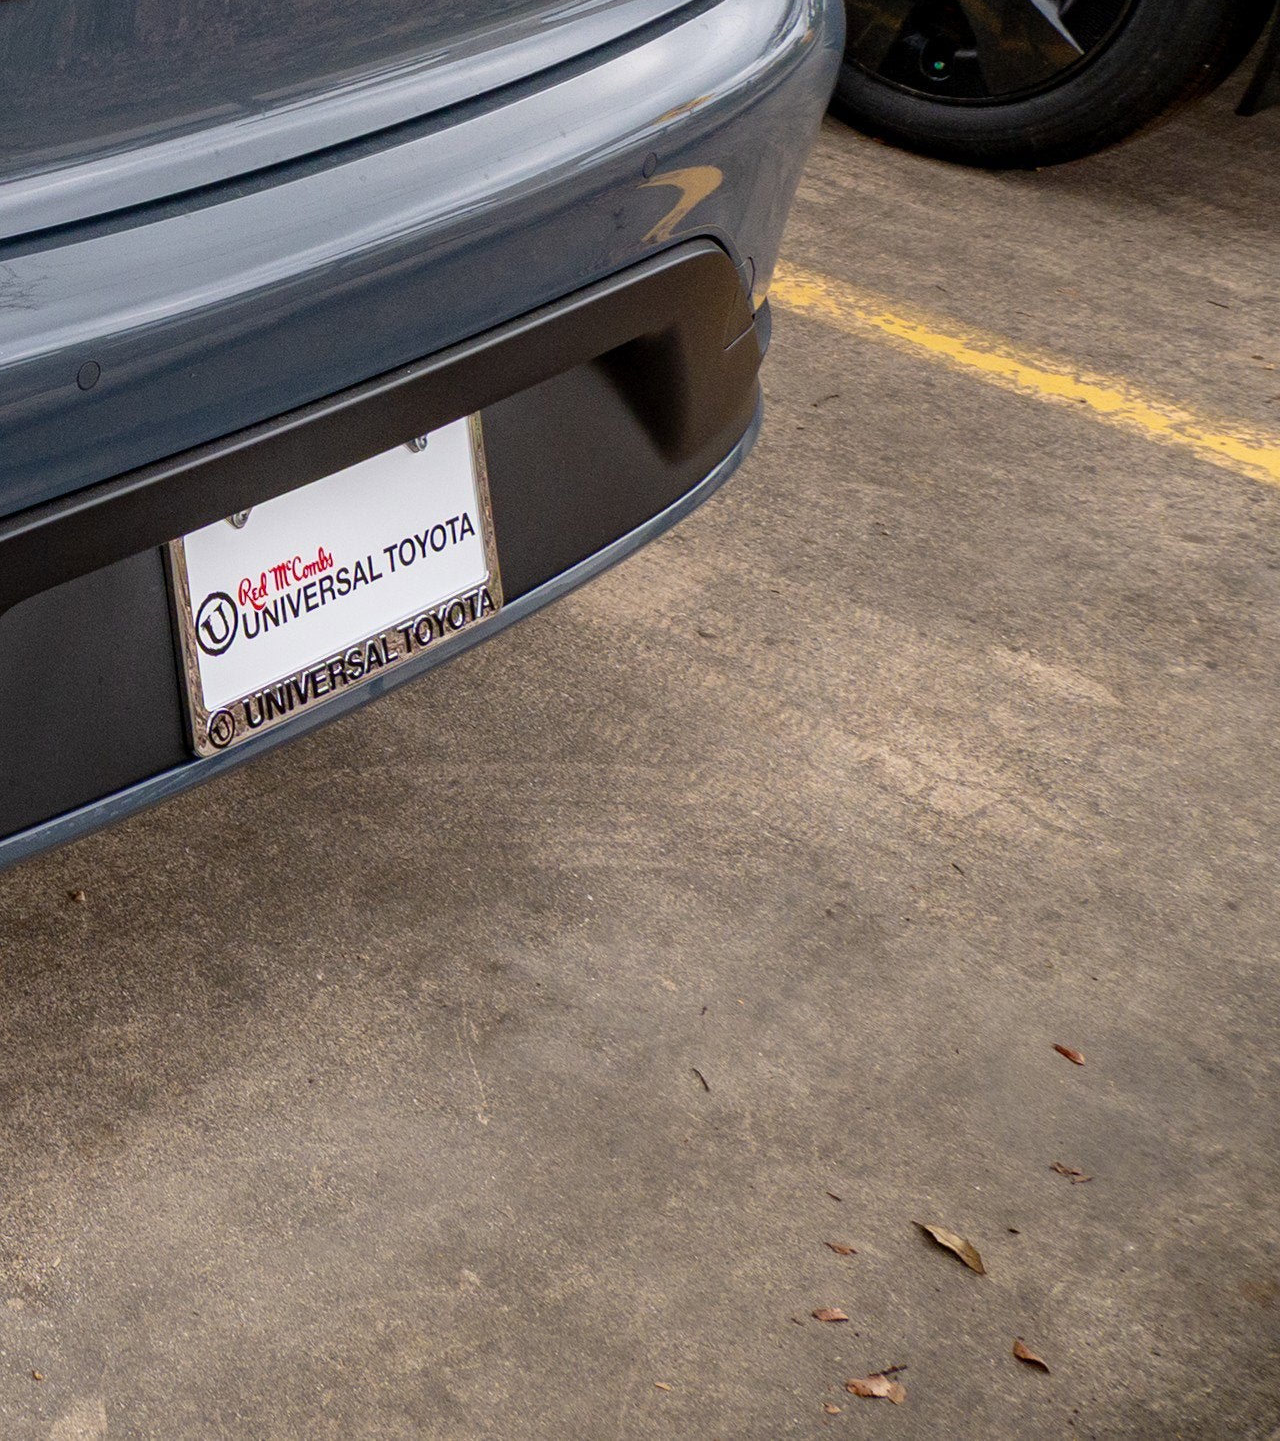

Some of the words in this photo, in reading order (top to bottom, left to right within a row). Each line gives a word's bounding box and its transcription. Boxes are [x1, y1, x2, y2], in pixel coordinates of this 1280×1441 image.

[238, 571, 269, 611] Red
[268, 546, 334, 592] McCombs
[241, 555, 383, 640] UNIVERSAL
[383, 512, 476, 574] TOYOTA
[242, 633, 398, 731] UNIVERSAL
[397, 585, 496, 655] TOYOTA
